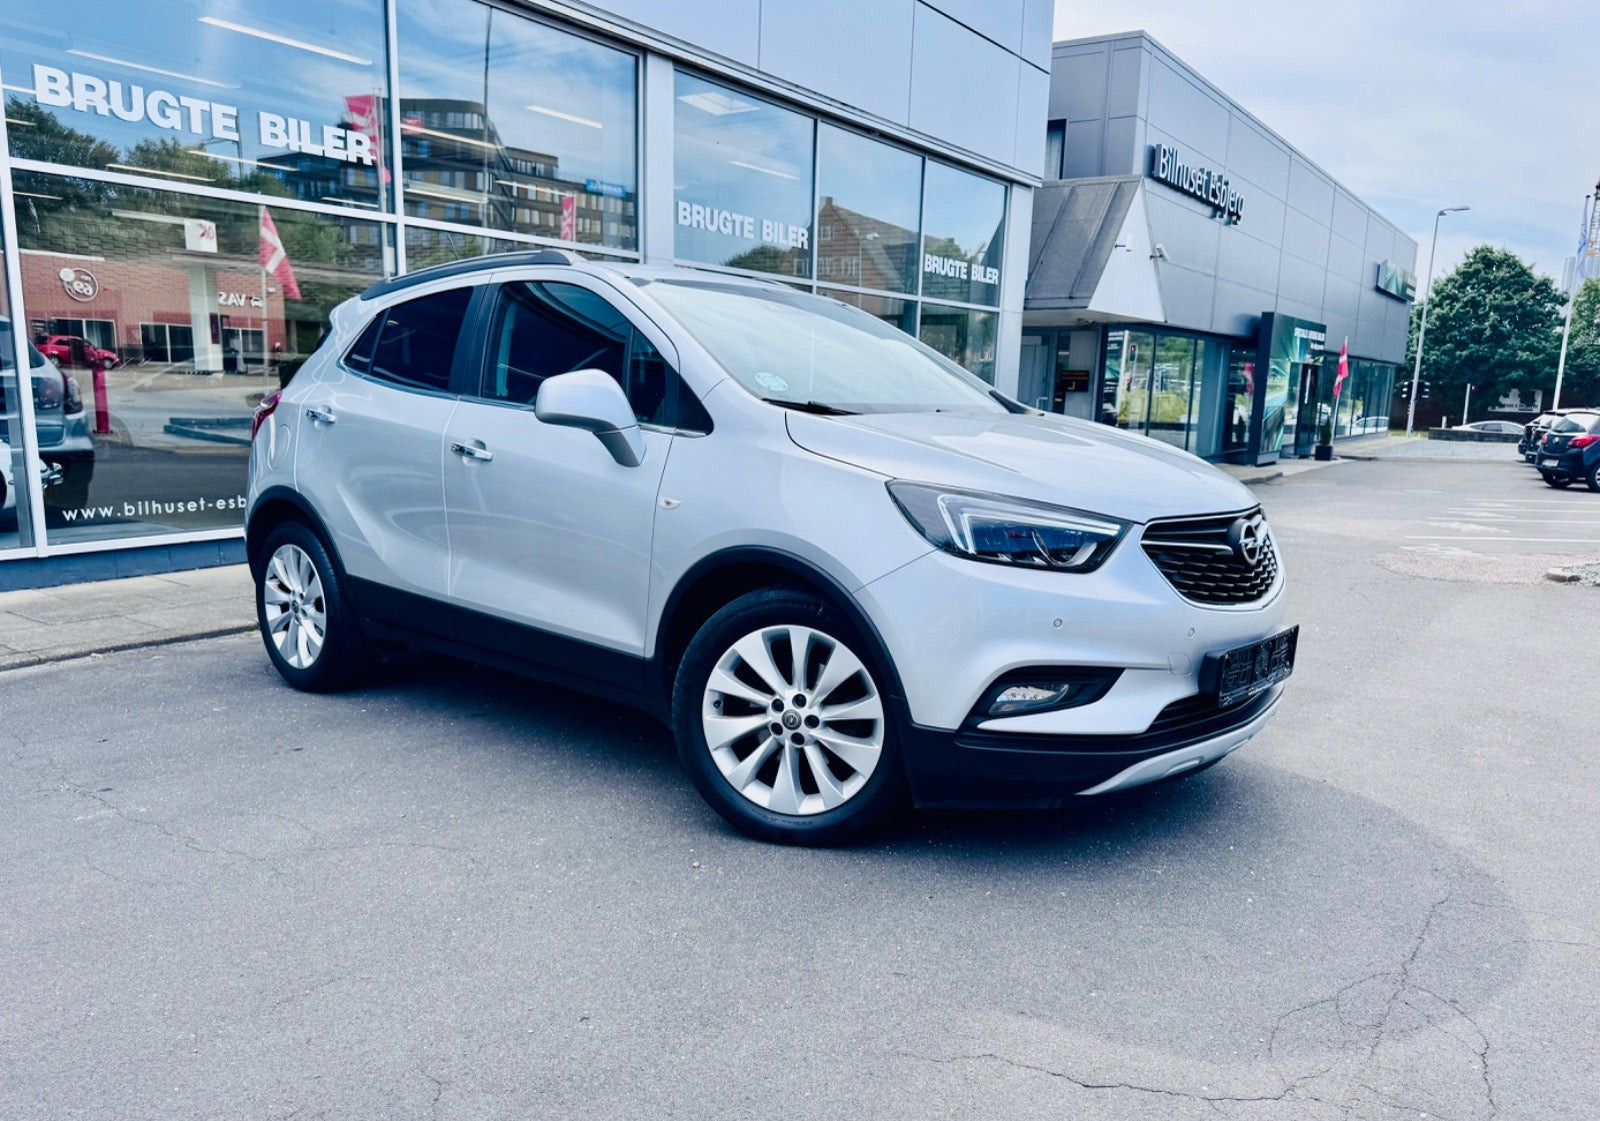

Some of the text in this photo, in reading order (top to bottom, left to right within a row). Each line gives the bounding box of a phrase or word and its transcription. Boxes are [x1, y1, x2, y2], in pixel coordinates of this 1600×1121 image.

[33, 63, 374, 165] BRUGTE BILER
[1158, 143, 1245, 225] Bilhuset Esbjerg
[677, 200, 809, 249] BRUGTE BILER
[924, 253, 999, 285] BRUGTE BILER
[62, 495, 247, 521] www.bilhuset-esb
